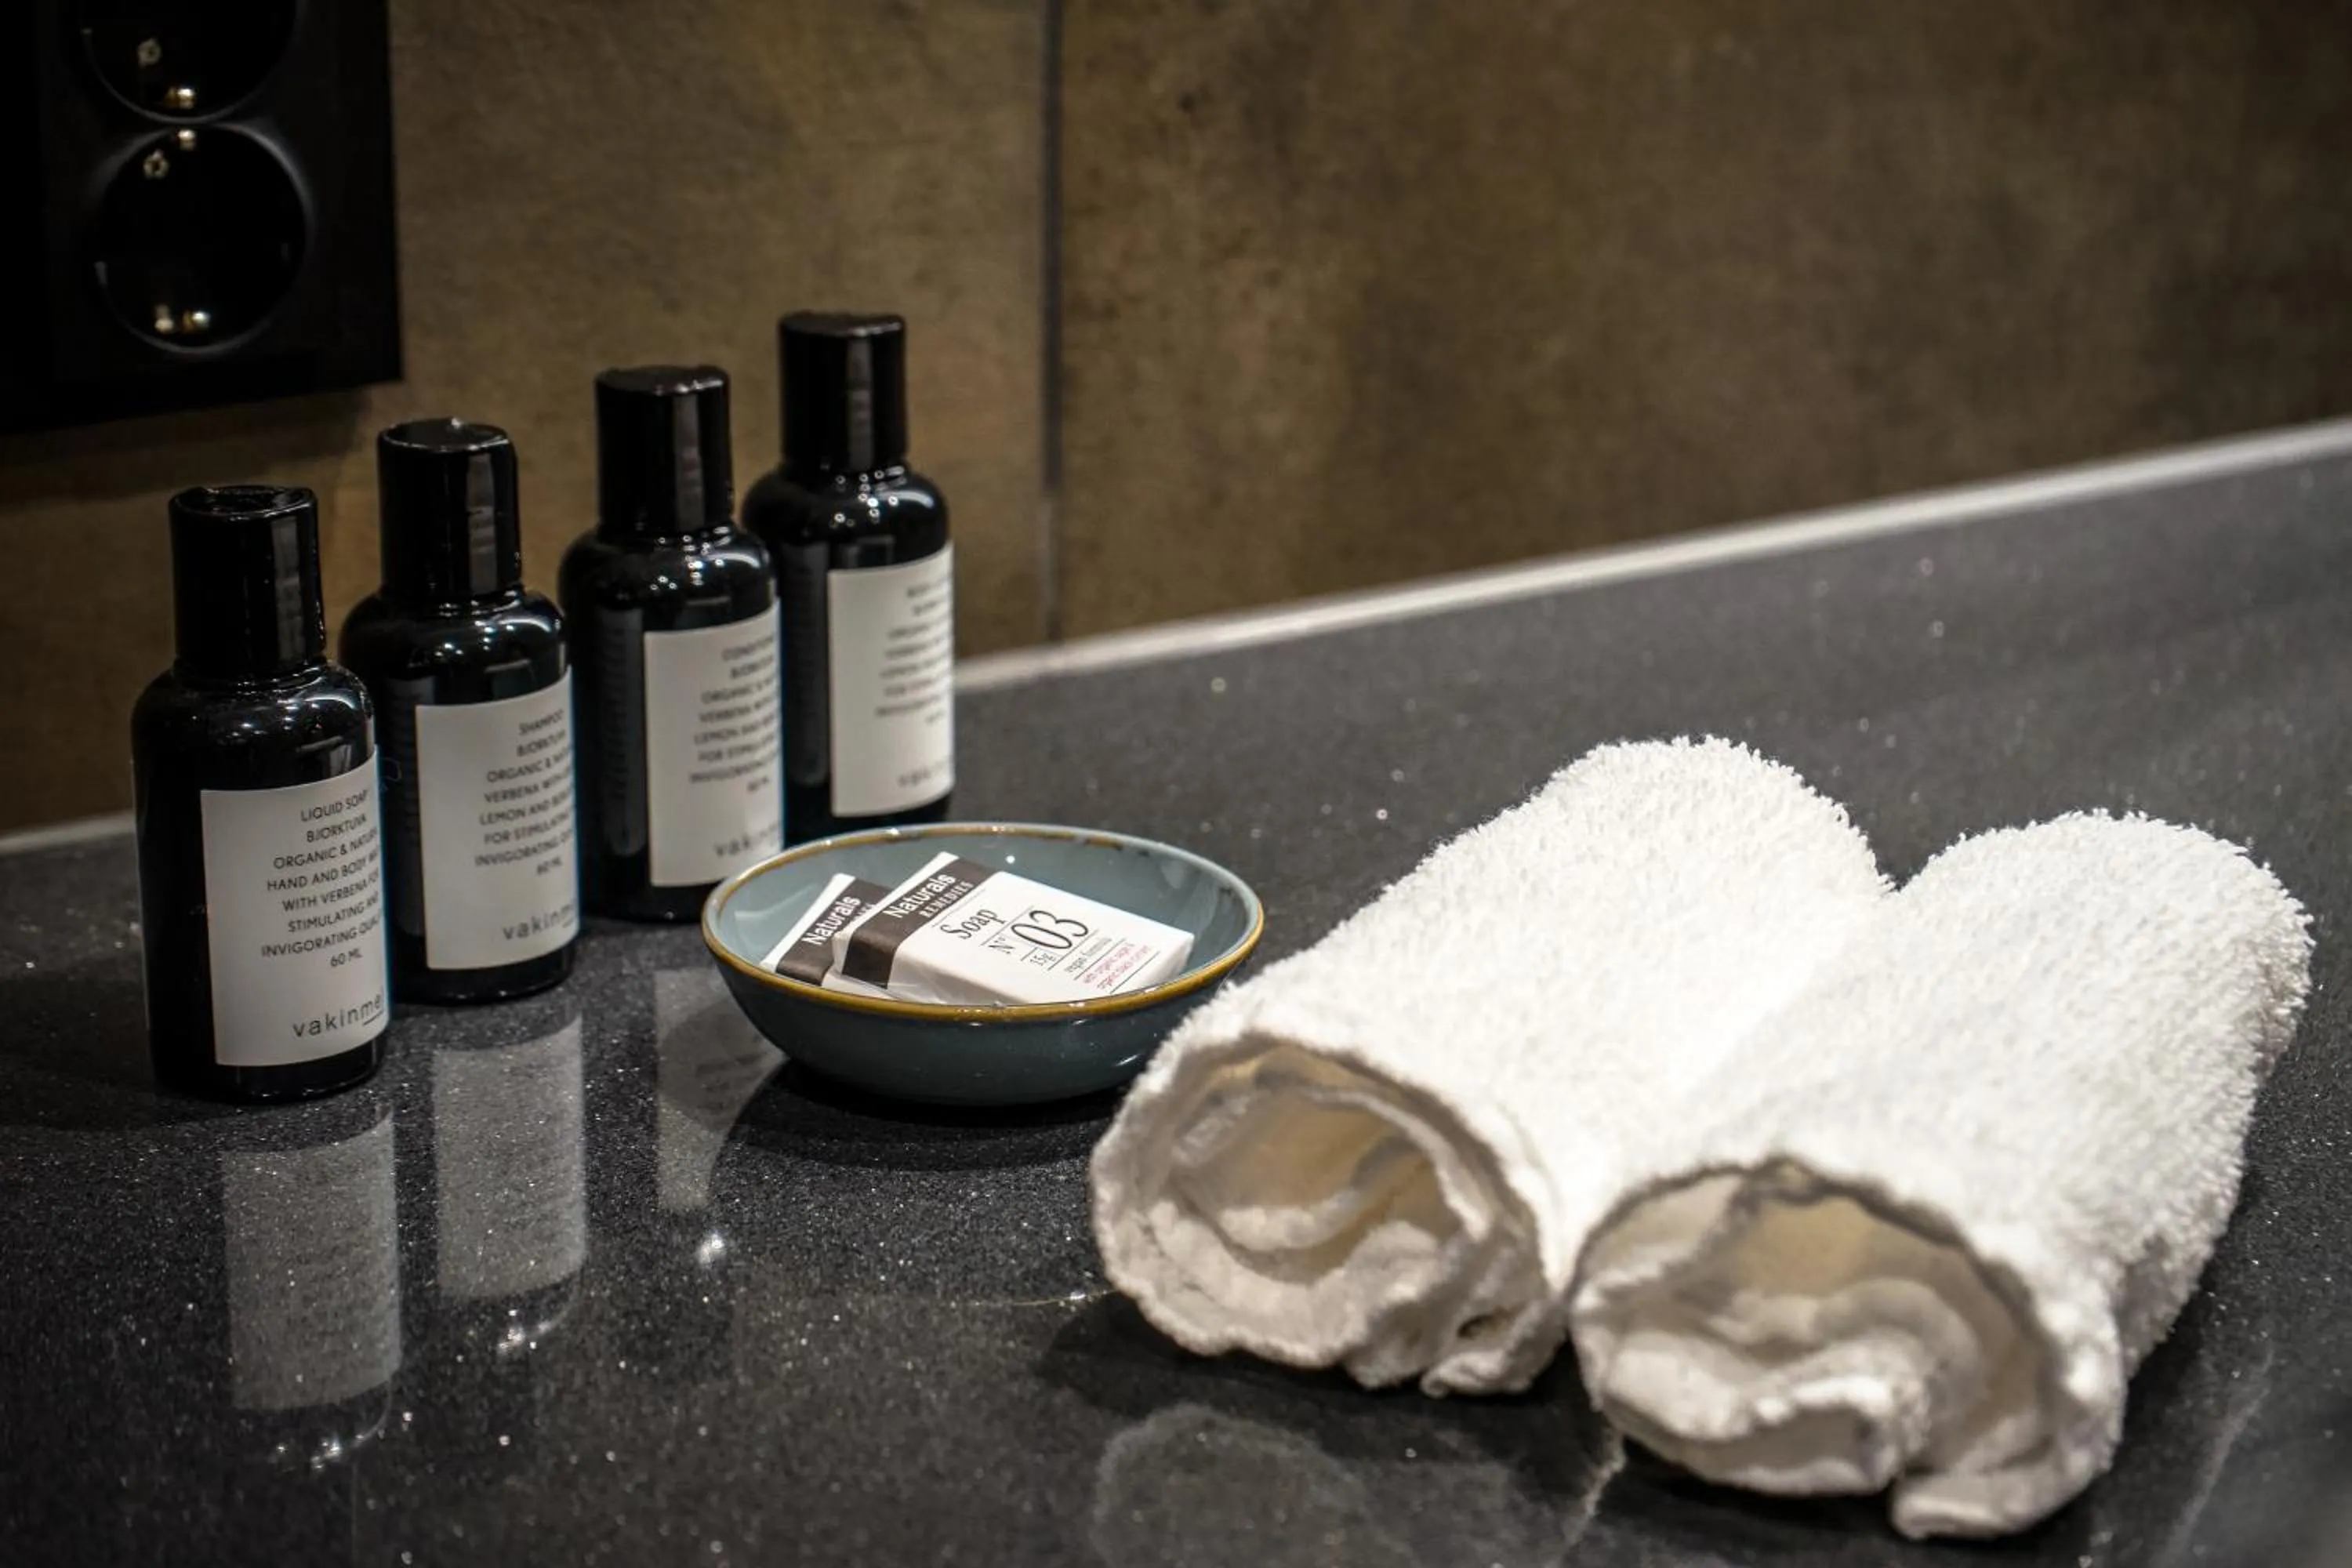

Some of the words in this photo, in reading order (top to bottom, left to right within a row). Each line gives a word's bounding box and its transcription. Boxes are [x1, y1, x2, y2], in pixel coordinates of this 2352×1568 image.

[486, 760, 542, 783] ORGANIC
[483, 783, 539, 804] VERBENA
[300, 801, 343, 822] LIQUID
[479, 808, 526, 826] LEMON
[484, 829, 511, 845] FOR
[274, 847, 337, 869] ORGANIC
[340, 844, 348, 855] &
[267, 875, 308, 892] HAND
[312, 868, 339, 885] AND
[342, 857, 366, 878] BODY
[282, 895, 318, 913] WITH
[321, 878, 368, 904] VERBENA
[883, 873, 956, 919] Naturals
[918, 880, 975, 918] REMEDIES
[288, 902, 365, 933] STIMULATING
[800, 895, 862, 946] Naturals
[939, 908, 1008, 940] Soap
[1011, 909, 1089, 950] 03
[261, 927, 358, 957] INVIGORATING
[330, 952, 346, 967] 60
